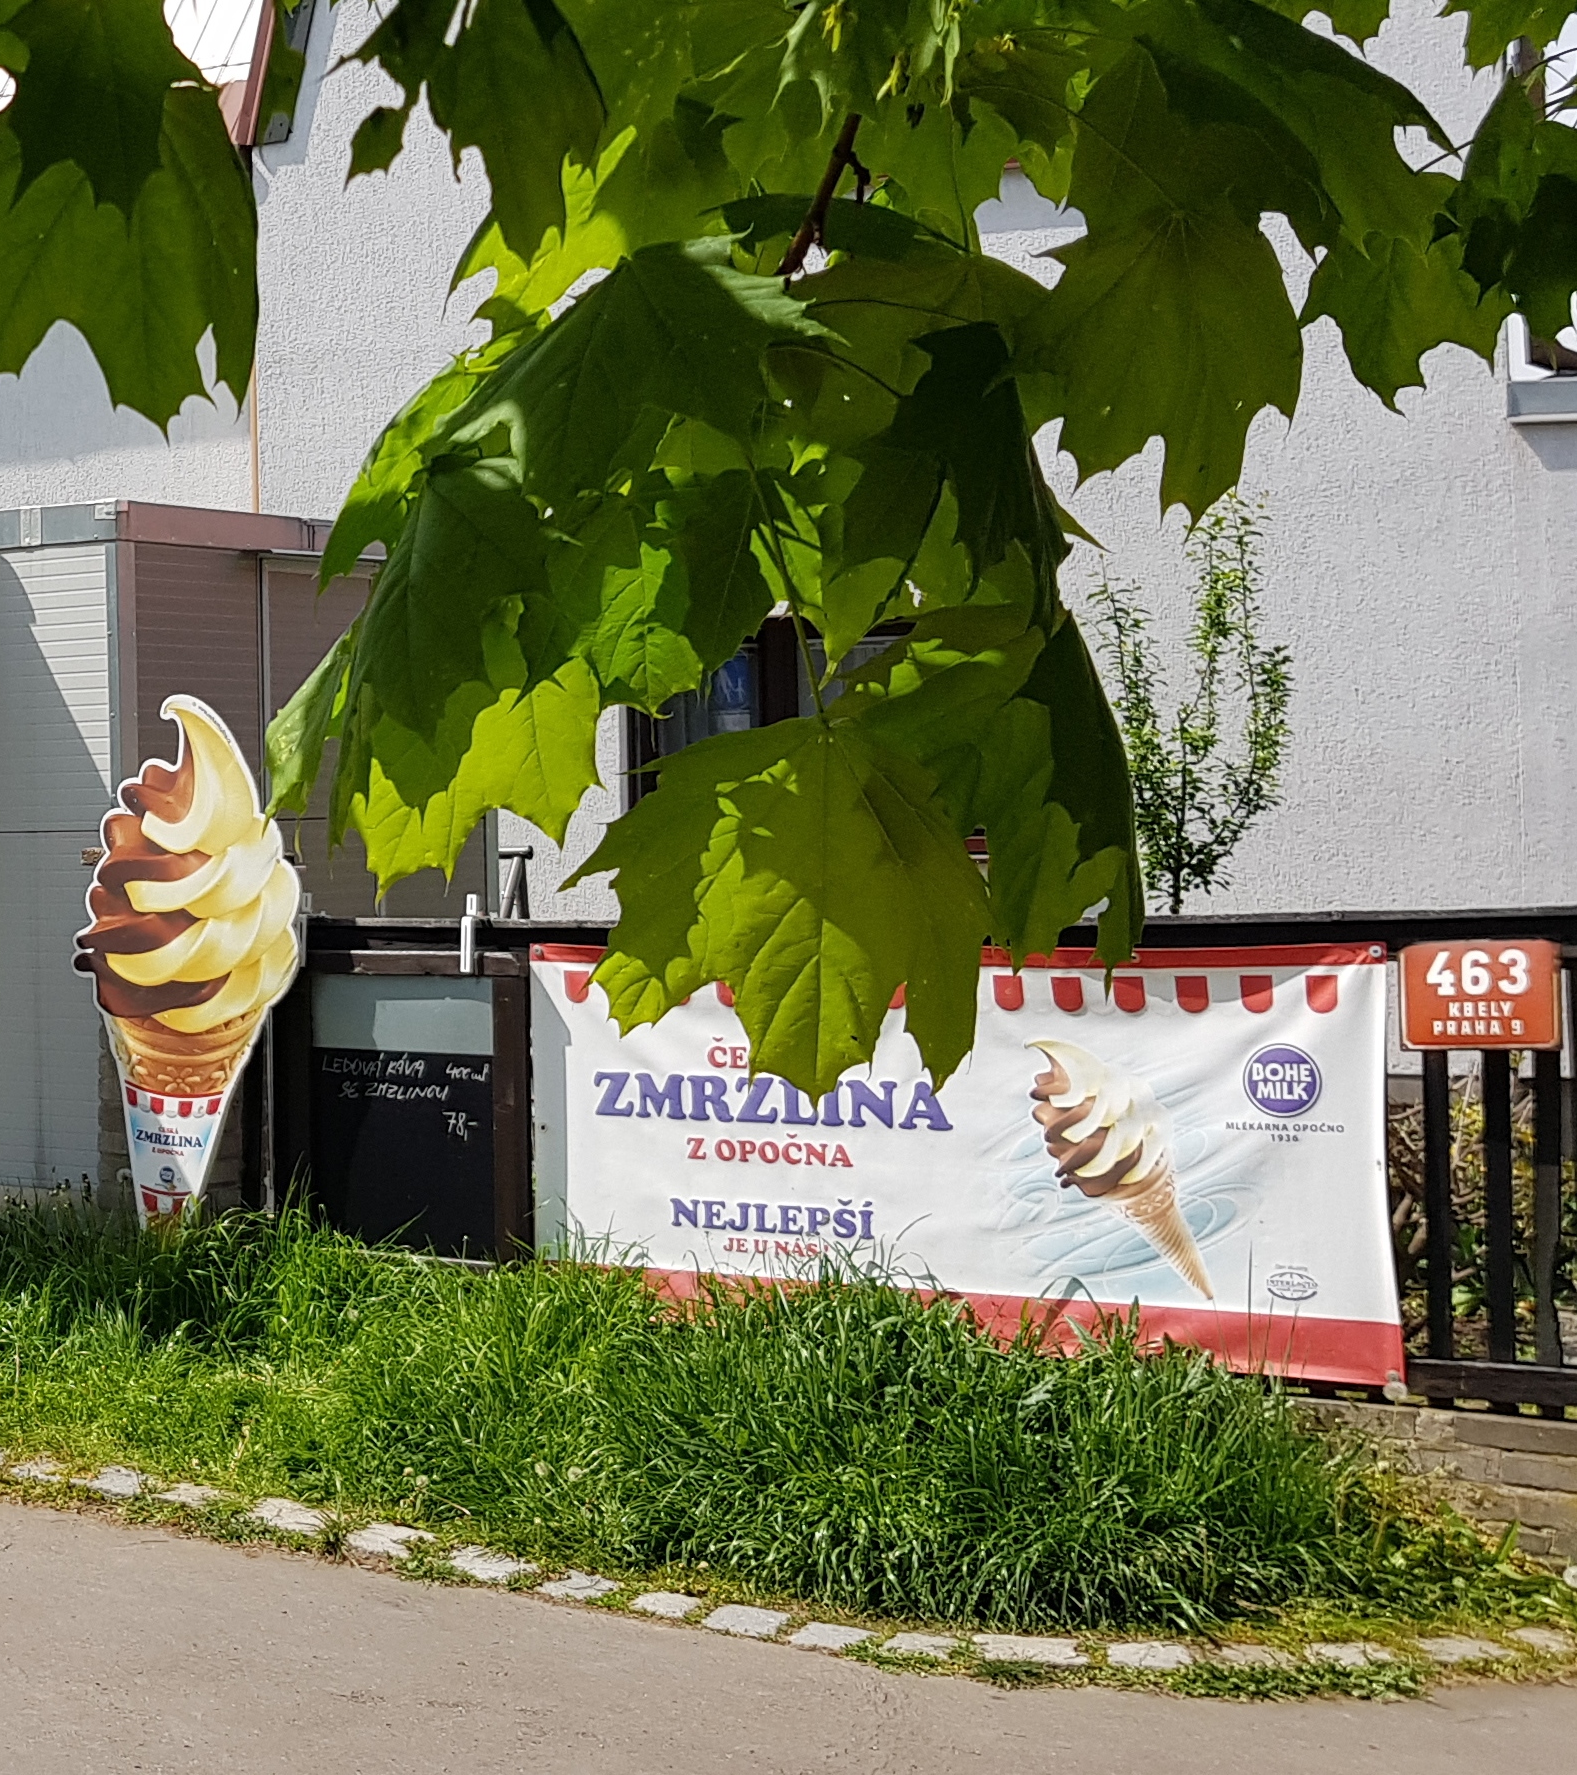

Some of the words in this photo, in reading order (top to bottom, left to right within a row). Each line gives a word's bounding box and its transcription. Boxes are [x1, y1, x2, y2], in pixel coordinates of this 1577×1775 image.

[1426, 948, 1531, 996] 463
[1448, 1001, 1515, 1018] KBELY
[1432, 1019, 1504, 1036] PRAHA
[1510, 1019, 1525, 1036] 9
[322, 1052, 384, 1078] LEDOVÁ
[385, 1051, 426, 1078] KÁVA
[1251, 1062, 1312, 1082] BOHE
[338, 1080, 360, 1098] SE
[1256, 1081, 1309, 1100] MILK
[593, 1071, 954, 1131] ZMRZLINA
[1225, 1121, 1289, 1132] MLÉKÁRNA
[1292, 1122, 1345, 1133] OPOČNO
[135, 1129, 203, 1148] ZMRZLINA
[1270, 1133, 1299, 1142] 1936
[686, 1137, 707, 1160] Z
[714, 1133, 854, 1167] OPOČNA
[669, 1197, 874, 1240] NEJLEPŠÍ
[723, 1237, 749, 1253] JE
[753, 1238, 768, 1254] U
